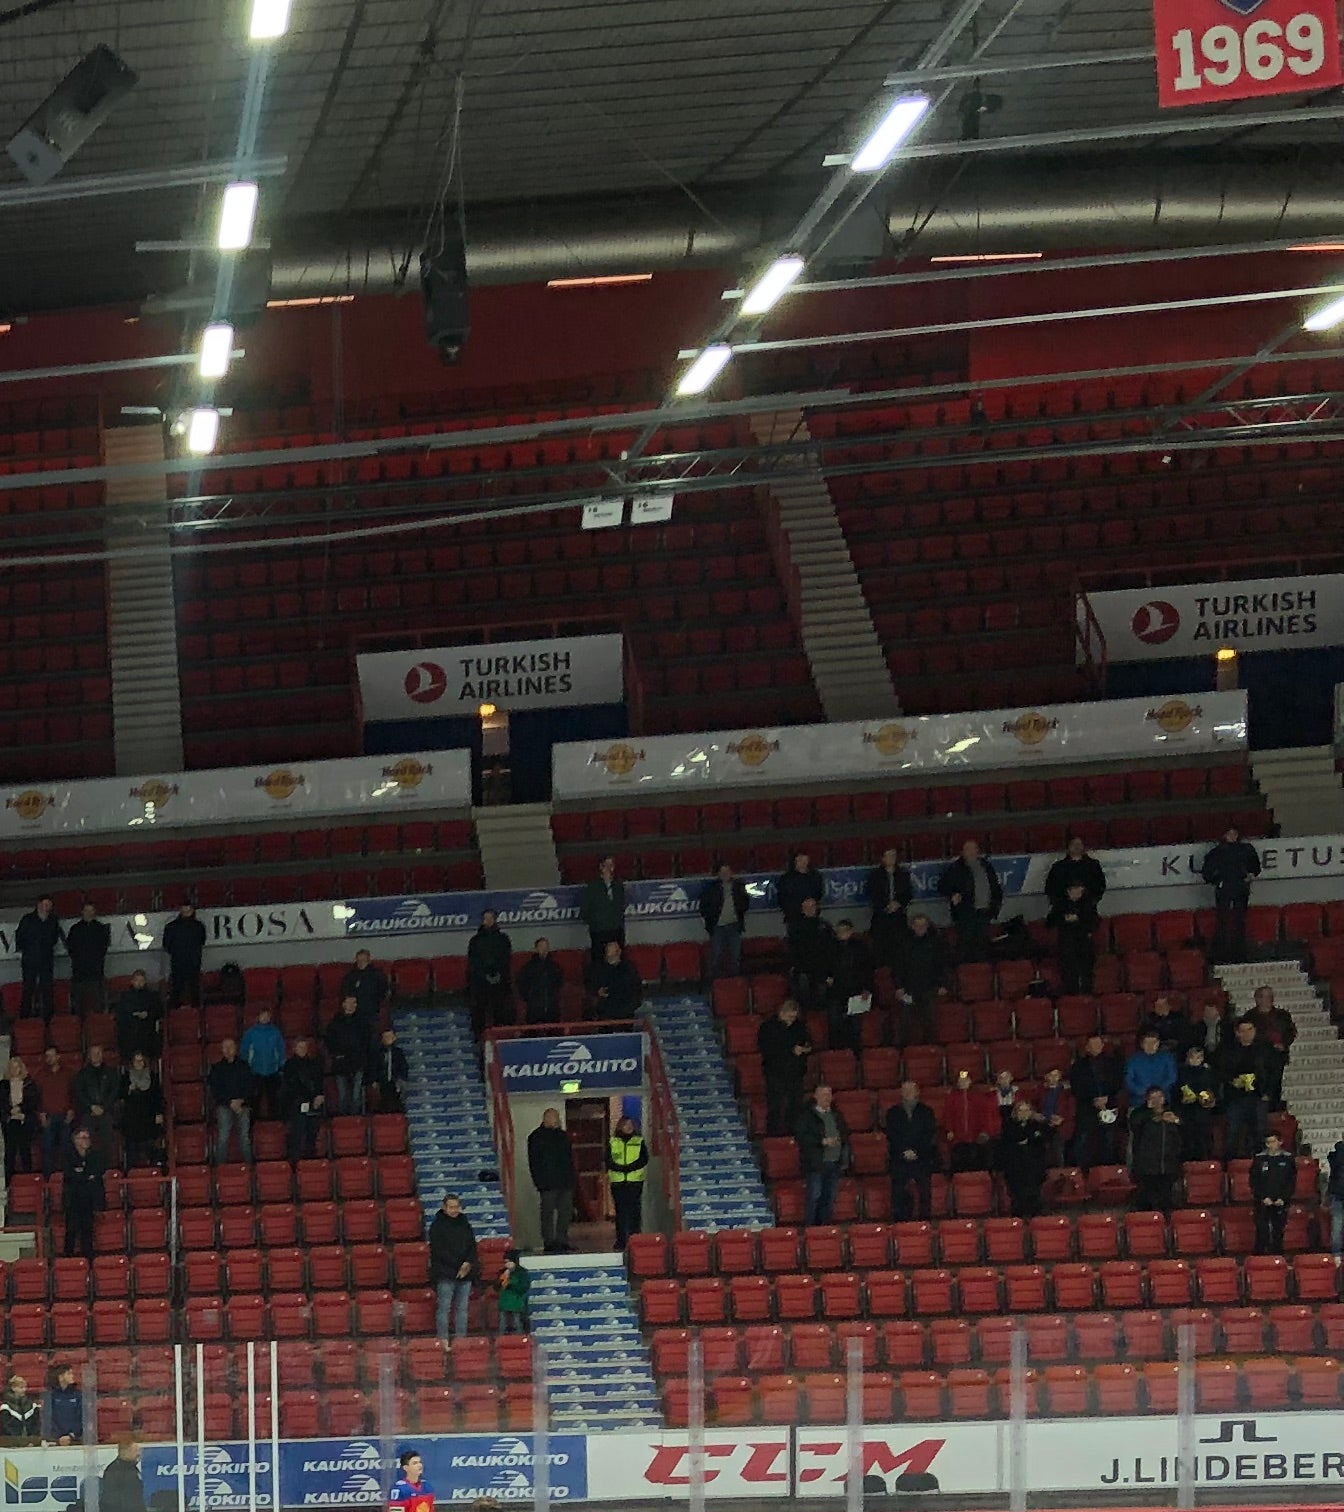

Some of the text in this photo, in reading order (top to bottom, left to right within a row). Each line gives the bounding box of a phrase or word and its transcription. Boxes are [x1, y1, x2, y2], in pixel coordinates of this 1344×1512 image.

[1172, 13, 1325, 92] 1969
[1195, 590, 1316, 617] TURKISH
[1194, 613, 1317, 641] AIRLINES
[459, 651, 572, 677] TURKISH
[459, 673, 572, 702] AIRLINES
[1161, 846, 1344, 876] KUETU
[496, 906, 581, 923] AUKOKII
[624, 899, 701, 916] AUKOKII
[213, 909, 315, 941] ROSA
[355, 912, 469, 933] KAUKOKIITO
[502, 1056, 638, 1079] KAUKOKIITO
